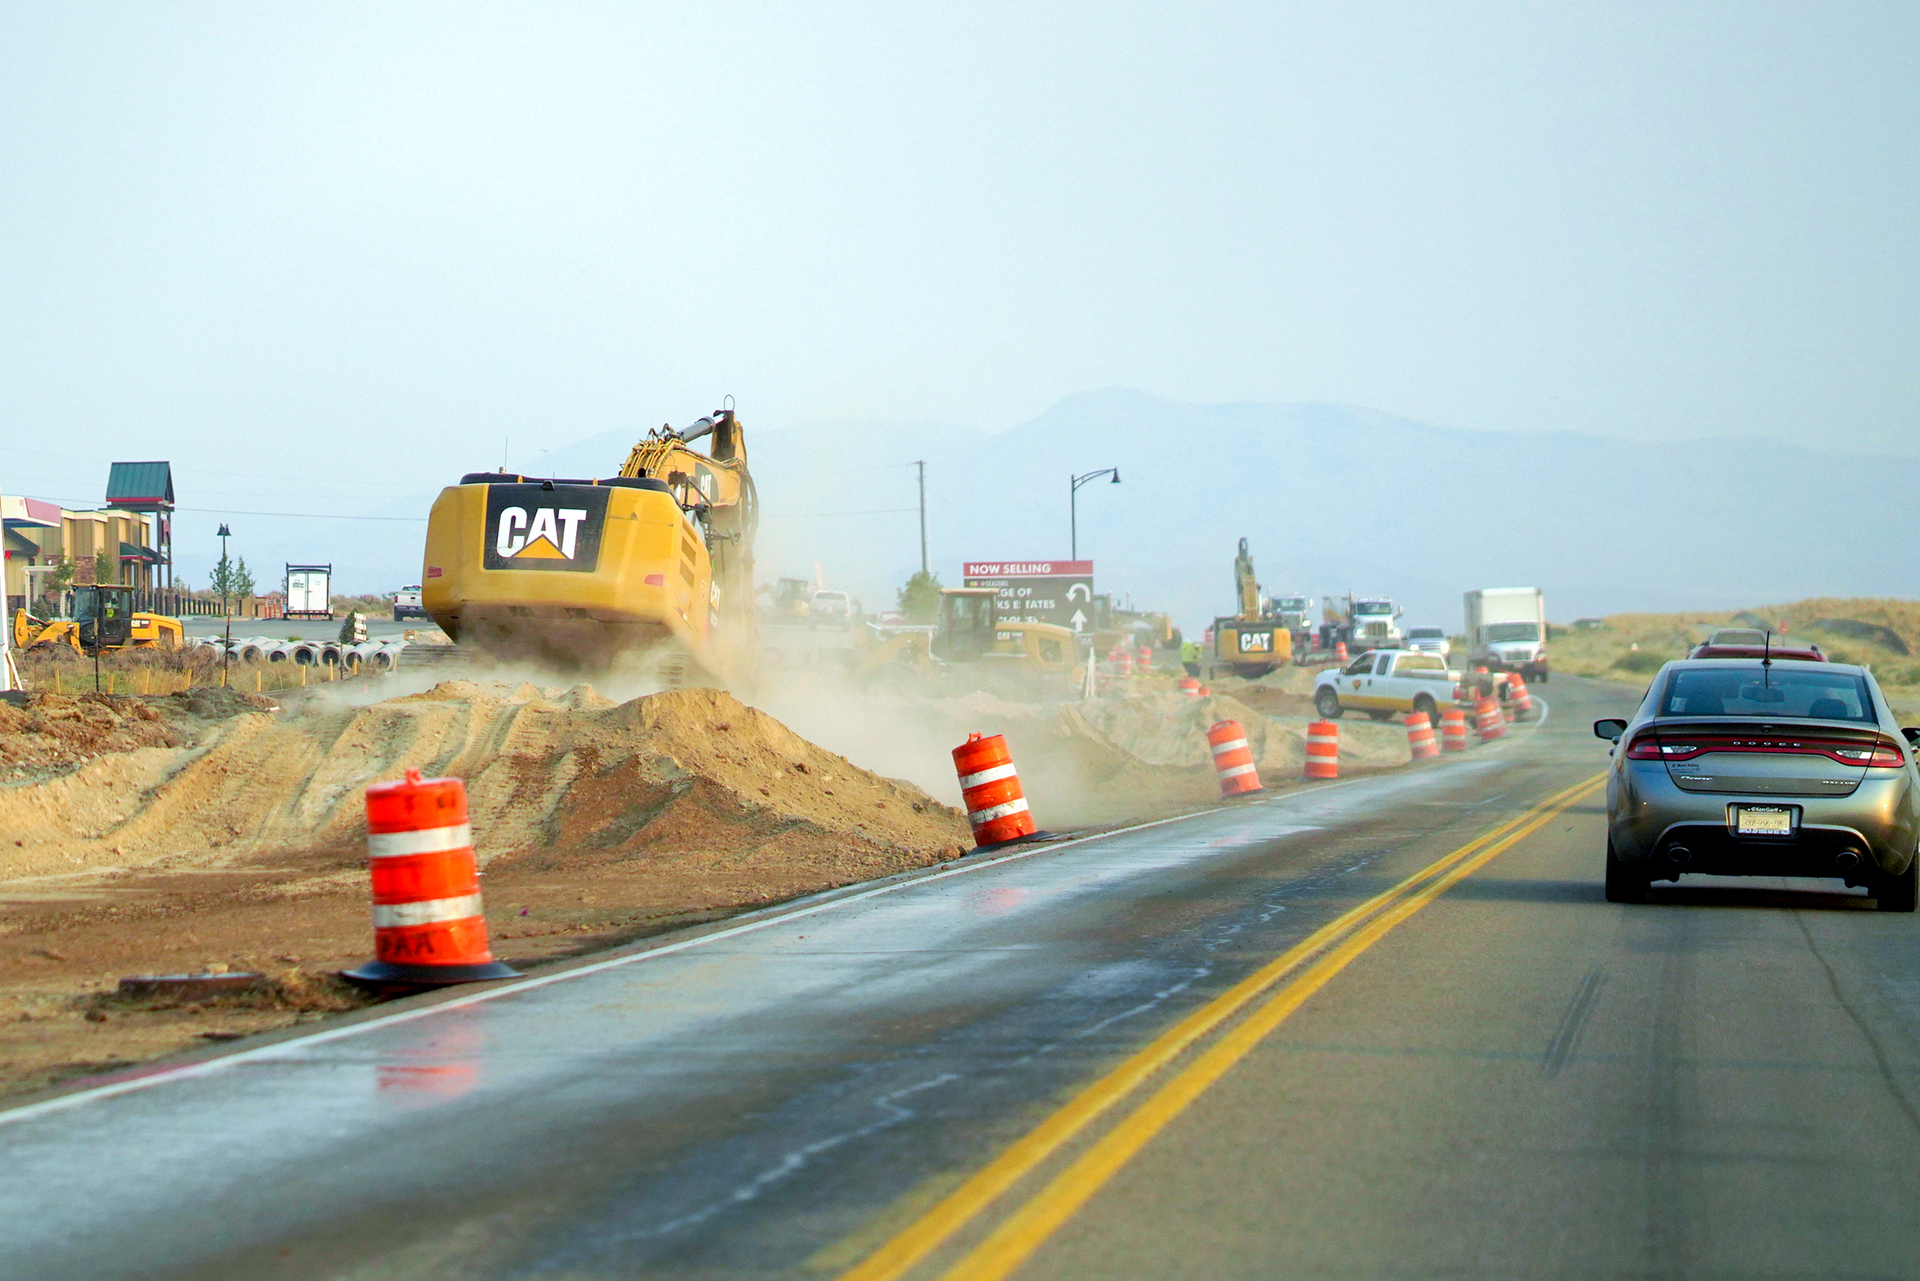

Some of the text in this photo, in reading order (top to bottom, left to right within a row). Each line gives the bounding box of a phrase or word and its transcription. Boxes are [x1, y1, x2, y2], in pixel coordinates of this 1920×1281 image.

[496, 506, 588, 560] CAT
[969, 563, 1052, 575] NOW SELLING
[1017, 587, 1032, 597] OF
[1241, 632, 1271, 652] CAT
